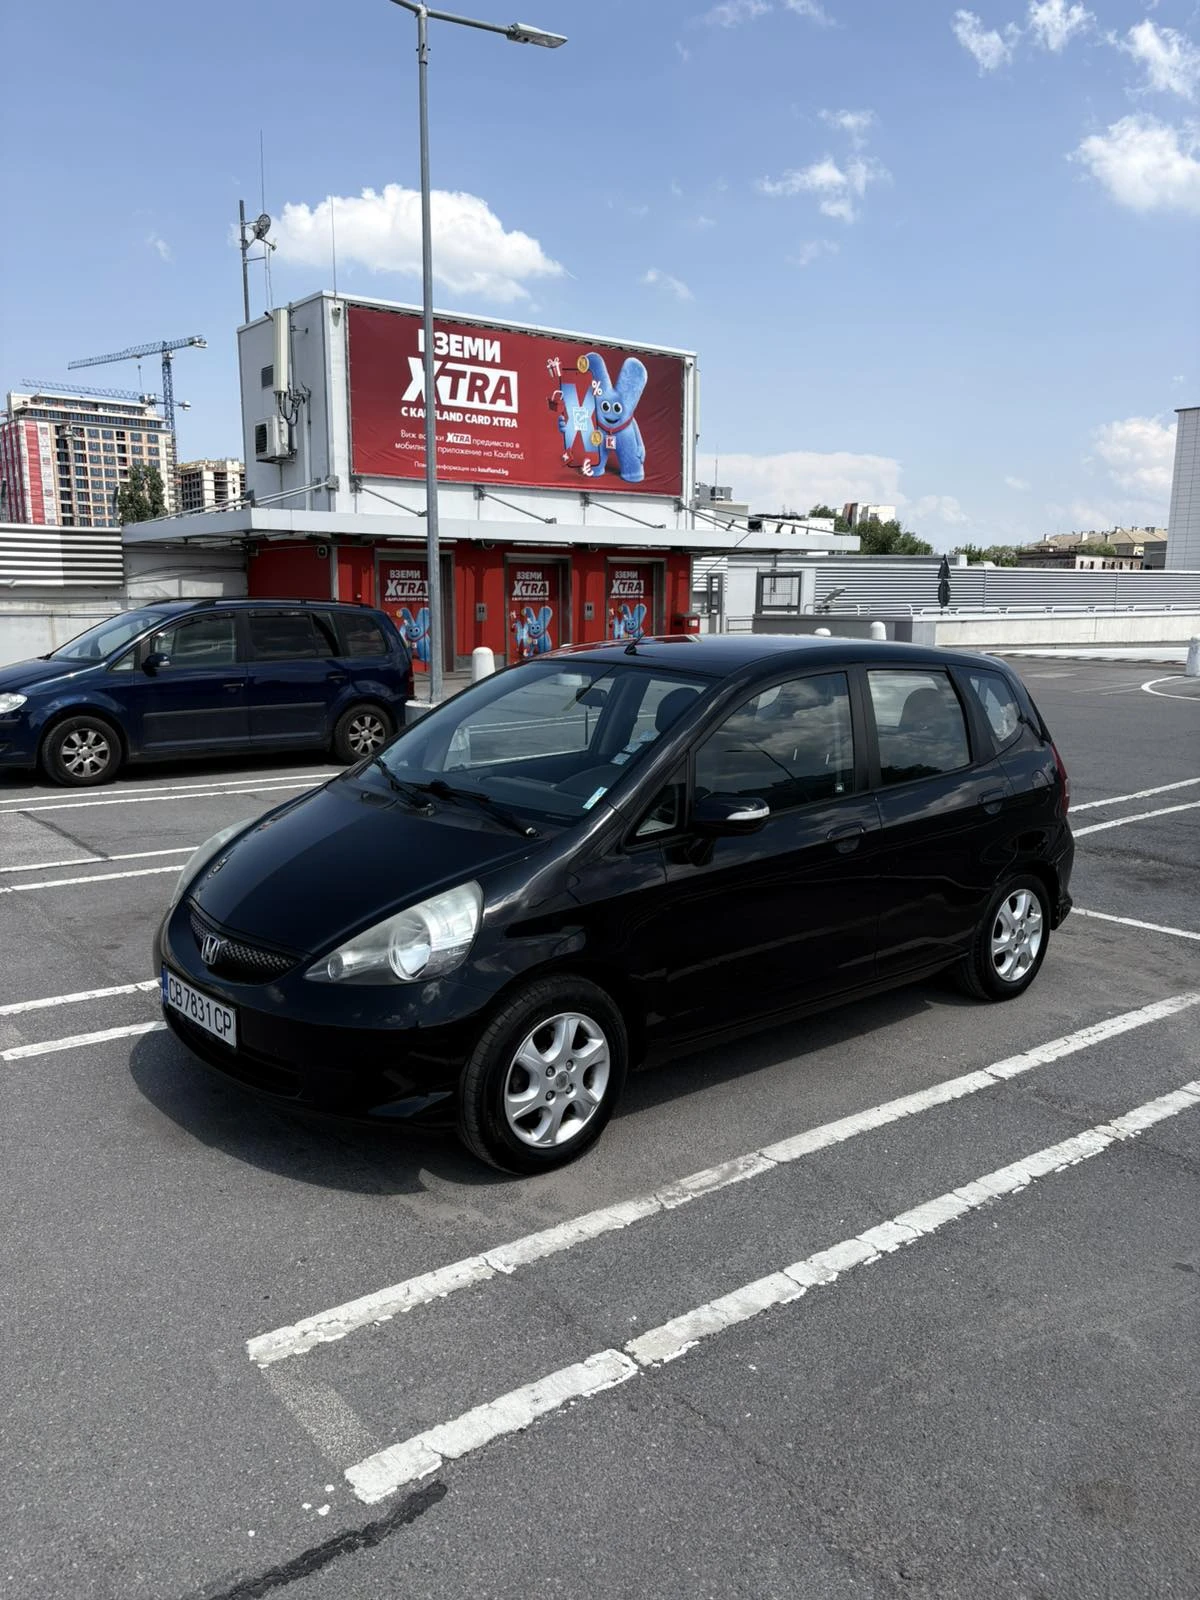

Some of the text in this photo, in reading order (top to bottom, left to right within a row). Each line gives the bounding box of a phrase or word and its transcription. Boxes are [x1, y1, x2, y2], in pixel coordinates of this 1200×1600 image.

[401, 357, 518, 413] XTRA
[410, 407, 463, 422] KALAND
[465, 414, 491, 425] CARD
[492, 416, 518, 428] XTRA
[400, 429, 416, 438] Виж
[418, 433, 444, 441] вски
[446, 432, 471, 444] XTRA
[390, 570, 420, 579] ВЗЕМИ
[385, 580, 428, 596] XTRA
[512, 581, 549, 596] XTRA
[611, 580, 644, 594] XTRA
